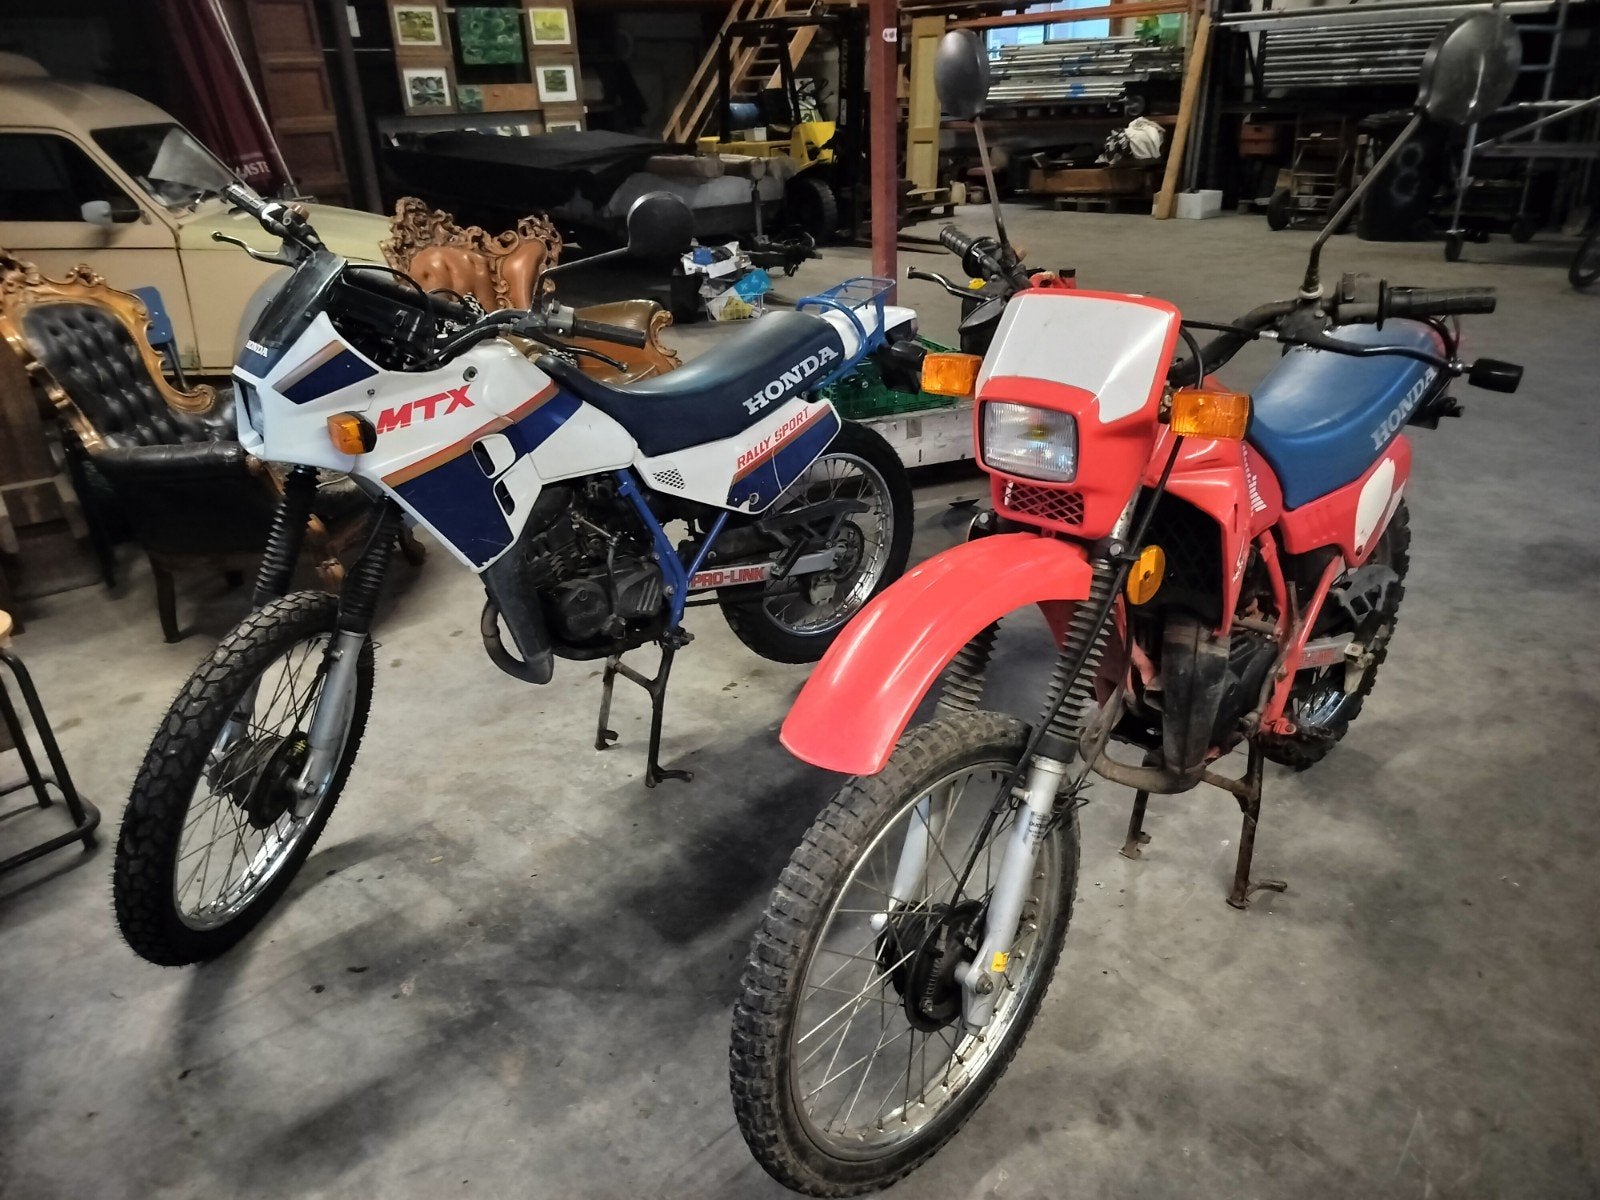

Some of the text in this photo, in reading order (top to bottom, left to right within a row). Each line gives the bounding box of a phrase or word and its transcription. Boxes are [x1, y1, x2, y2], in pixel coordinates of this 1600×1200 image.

[376, 384, 476, 435] MTX
[742, 346, 839, 415] HONDA
[1370, 366, 1438, 451] HONDA
[736, 406, 809, 469] RALLY SPORT
[691, 566, 766, 588] PRO-LINK
